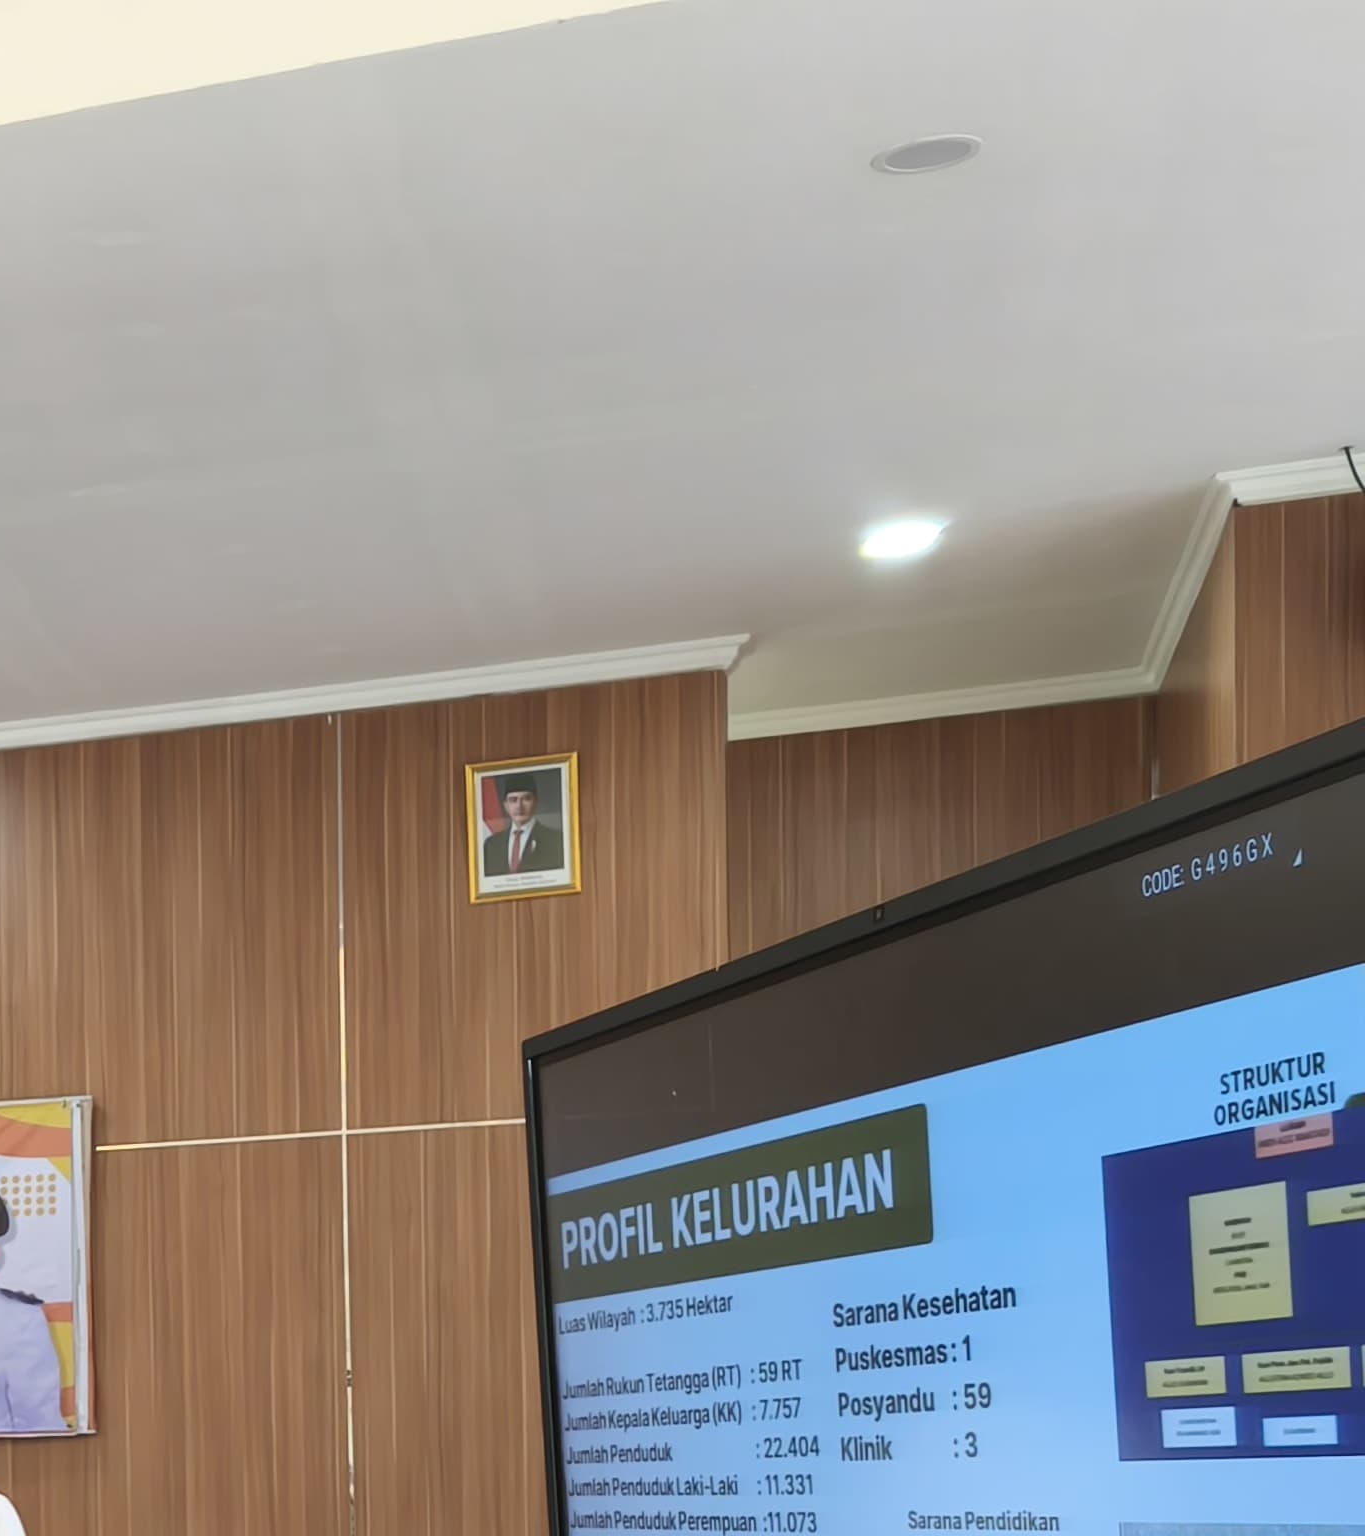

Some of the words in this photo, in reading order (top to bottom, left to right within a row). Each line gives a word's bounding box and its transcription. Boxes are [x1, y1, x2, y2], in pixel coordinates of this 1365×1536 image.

[1141, 864, 1185, 897] CODE:
[1220, 1051, 1326, 1096] STRUKTUR
[1214, 1081, 1336, 1127] ORGANISASI
[561, 1203, 663, 1269] PROFIL
[671, 1149, 895, 1249] KELURAHAN
[559, 1316, 586, 1335] Luas
[587, 1307, 636, 1332] Wilayah
[686, 1295, 733, 1317] Hektar
[833, 1302, 899, 1328] Sarana
[902, 1285, 1017, 1320] Kesehatan
[835, 1343, 948, 1373] Puskesmas
[563, 1379, 605, 1400] Jumlah
[606, 1374, 645, 1395] Rukun
[646, 1371, 710, 1395] Tetangga
[712, 1363, 742, 1391] (RT)
[758, 1361, 778, 1384] 59
[781, 1358, 803, 1382] RT
[565, 1412, 607, 1432] Jumlah
[609, 1409, 650, 1432] Kepala
[651, 1405, 710, 1429] Keluarga
[712, 1399, 742, 1427] (KK)
[759, 1396, 802, 1421] 7.757
[837, 1387, 936, 1423] Posyandu
[963, 1382, 992, 1410] 59
[566, 1446, 608, 1464] Jumlah
[609, 1442, 673, 1463] Penduduk
[764, 1436, 820, 1459] 22.404
[840, 1434, 893, 1462] Klinik
[964, 1431, 978, 1458] 3
[568, 1478, 611, 1497] Jumlah
[612, 1476, 674, 1497] Penduduk
[676, 1474, 739, 1496] Laki-Laki
[570, 1511, 613, 1529] Jumlah
[614, 1510, 677, 1531] Penduduk
[678, 1511, 757, 1536] Perempuan
[908, 1510, 962, 1530] Sarana
[964, 1510, 1060, 1531] Pendidikan
